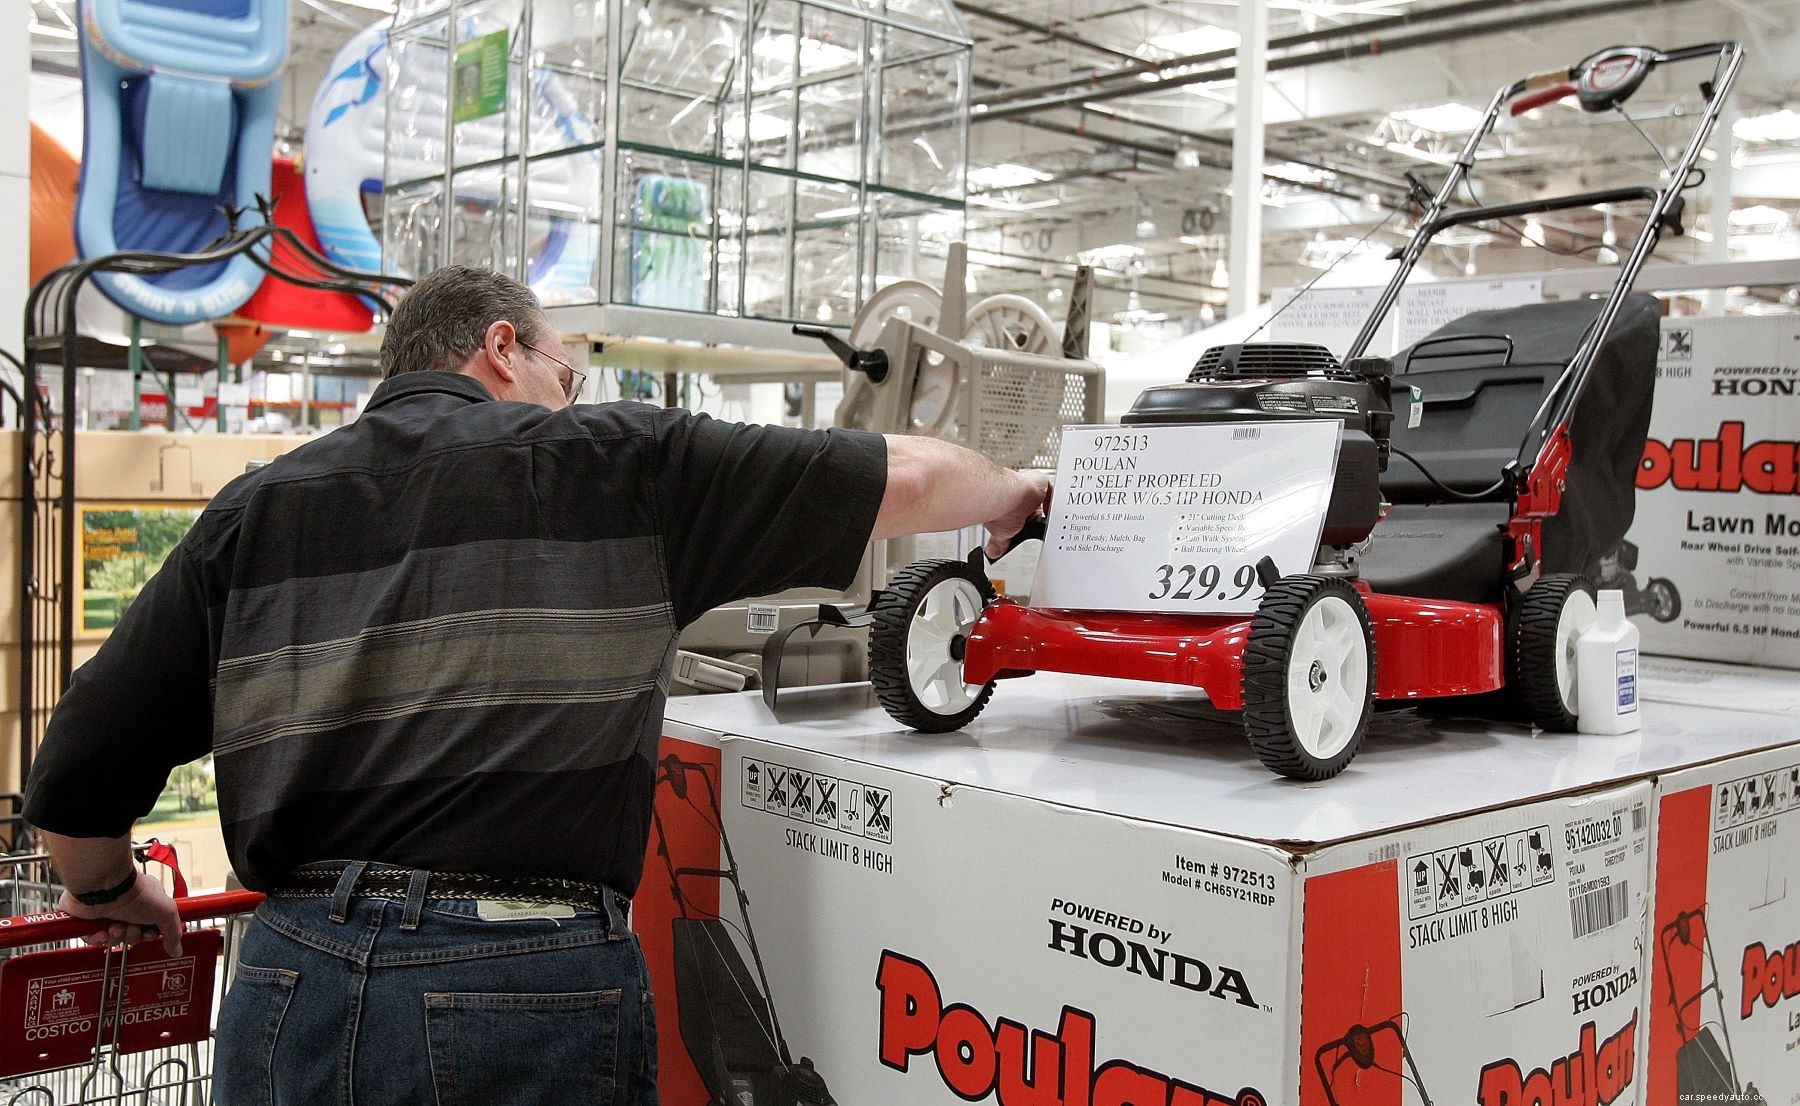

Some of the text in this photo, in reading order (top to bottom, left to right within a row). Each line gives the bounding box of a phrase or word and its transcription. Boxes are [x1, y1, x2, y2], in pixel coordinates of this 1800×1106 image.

[1666, 367, 1692, 378] HIGH
[1714, 366, 1799, 376] POWERED by
[1711, 378, 1800, 396] HON
[1094, 434, 1149, 452] 972513
[1073, 456, 1138, 471] POULAN
[1070, 473, 1222, 489] 21" SELF PROPELED
[1067, 490, 1263, 506] MOWER W/6.5 HP HONDA
[1071, 513, 1099, 521] Powerful
[1112, 513, 1123, 521] HP
[1124, 513, 1145, 521] Honda
[1201, 513, 1226, 522] Cutting
[1227, 513, 1245, 521] Deck
[1686, 510, 1754, 534] Lawn
[1070, 523, 1092, 532] Engine
[1186, 524, 1214, 532] Variable
[1215, 524, 1236, 533] Speed
[1132, 534, 1146, 543] Bag
[1202, 534, 1219, 543] Walk
[1065, 544, 1124, 553] and Side Discharge
[1181, 545, 1195, 553] Ball
[1196, 545, 1223, 554] Bearing
[1680, 540, 1704, 552] Rear
[1707, 541, 1740, 554] Wheel
[1744, 544, 1772, 555] Drive
[1726, 556, 1744, 566] with
[1746, 557, 1783, 569] Variable
[1148, 564, 1266, 601] 329.9
[1729, 588, 1766, 600] Convert
[1767, 590, 1788, 602] from
[1694, 598, 1703, 609] to
[1705, 598, 1750, 613] Discharge
[1752, 603, 1770, 613] with
[1772, 605, 1784, 614] no
[1683, 619, 1800, 639] Powerful 6.5 HP Hond
[749, 771, 758, 781] UP
[815, 817, 829, 825] spade
[840, 823, 852, 831] hand
[865, 829, 890, 841] razorback
[1713, 819, 1777, 854] STACK LIMIT 8 HIGH
[785, 828, 893, 874] STACK LIMIT 8 HIGH
[1175, 854, 1276, 890] Item # 972513
[1416, 871, 1426, 883] UP
[1533, 873, 1553, 884] razorback
[1162, 870, 1276, 907] Model # CH65Y21RDP
[1413, 886, 1430, 896] FRAGILE
[1512, 881, 1523, 889] hand
[1464, 893, 1478, 902] clamp
[1489, 888, 1502, 897] spade
[1438, 901, 1449, 910] fork
[1050, 898, 1172, 945] POWERED by
[1409, 898, 1519, 949] STACK LIMIT 8 HIGH
[1048, 918, 1274, 1014] HONDA TM
[43, 977, 57, 986] Your
[57, 975, 71, 983] child
[1572, 964, 1620, 989] POWERED by
[1571, 966, 1638, 1016] HONDA
[27, 989, 41, 1028] WARNING
[25, 1019, 92, 1041] COSTCO
